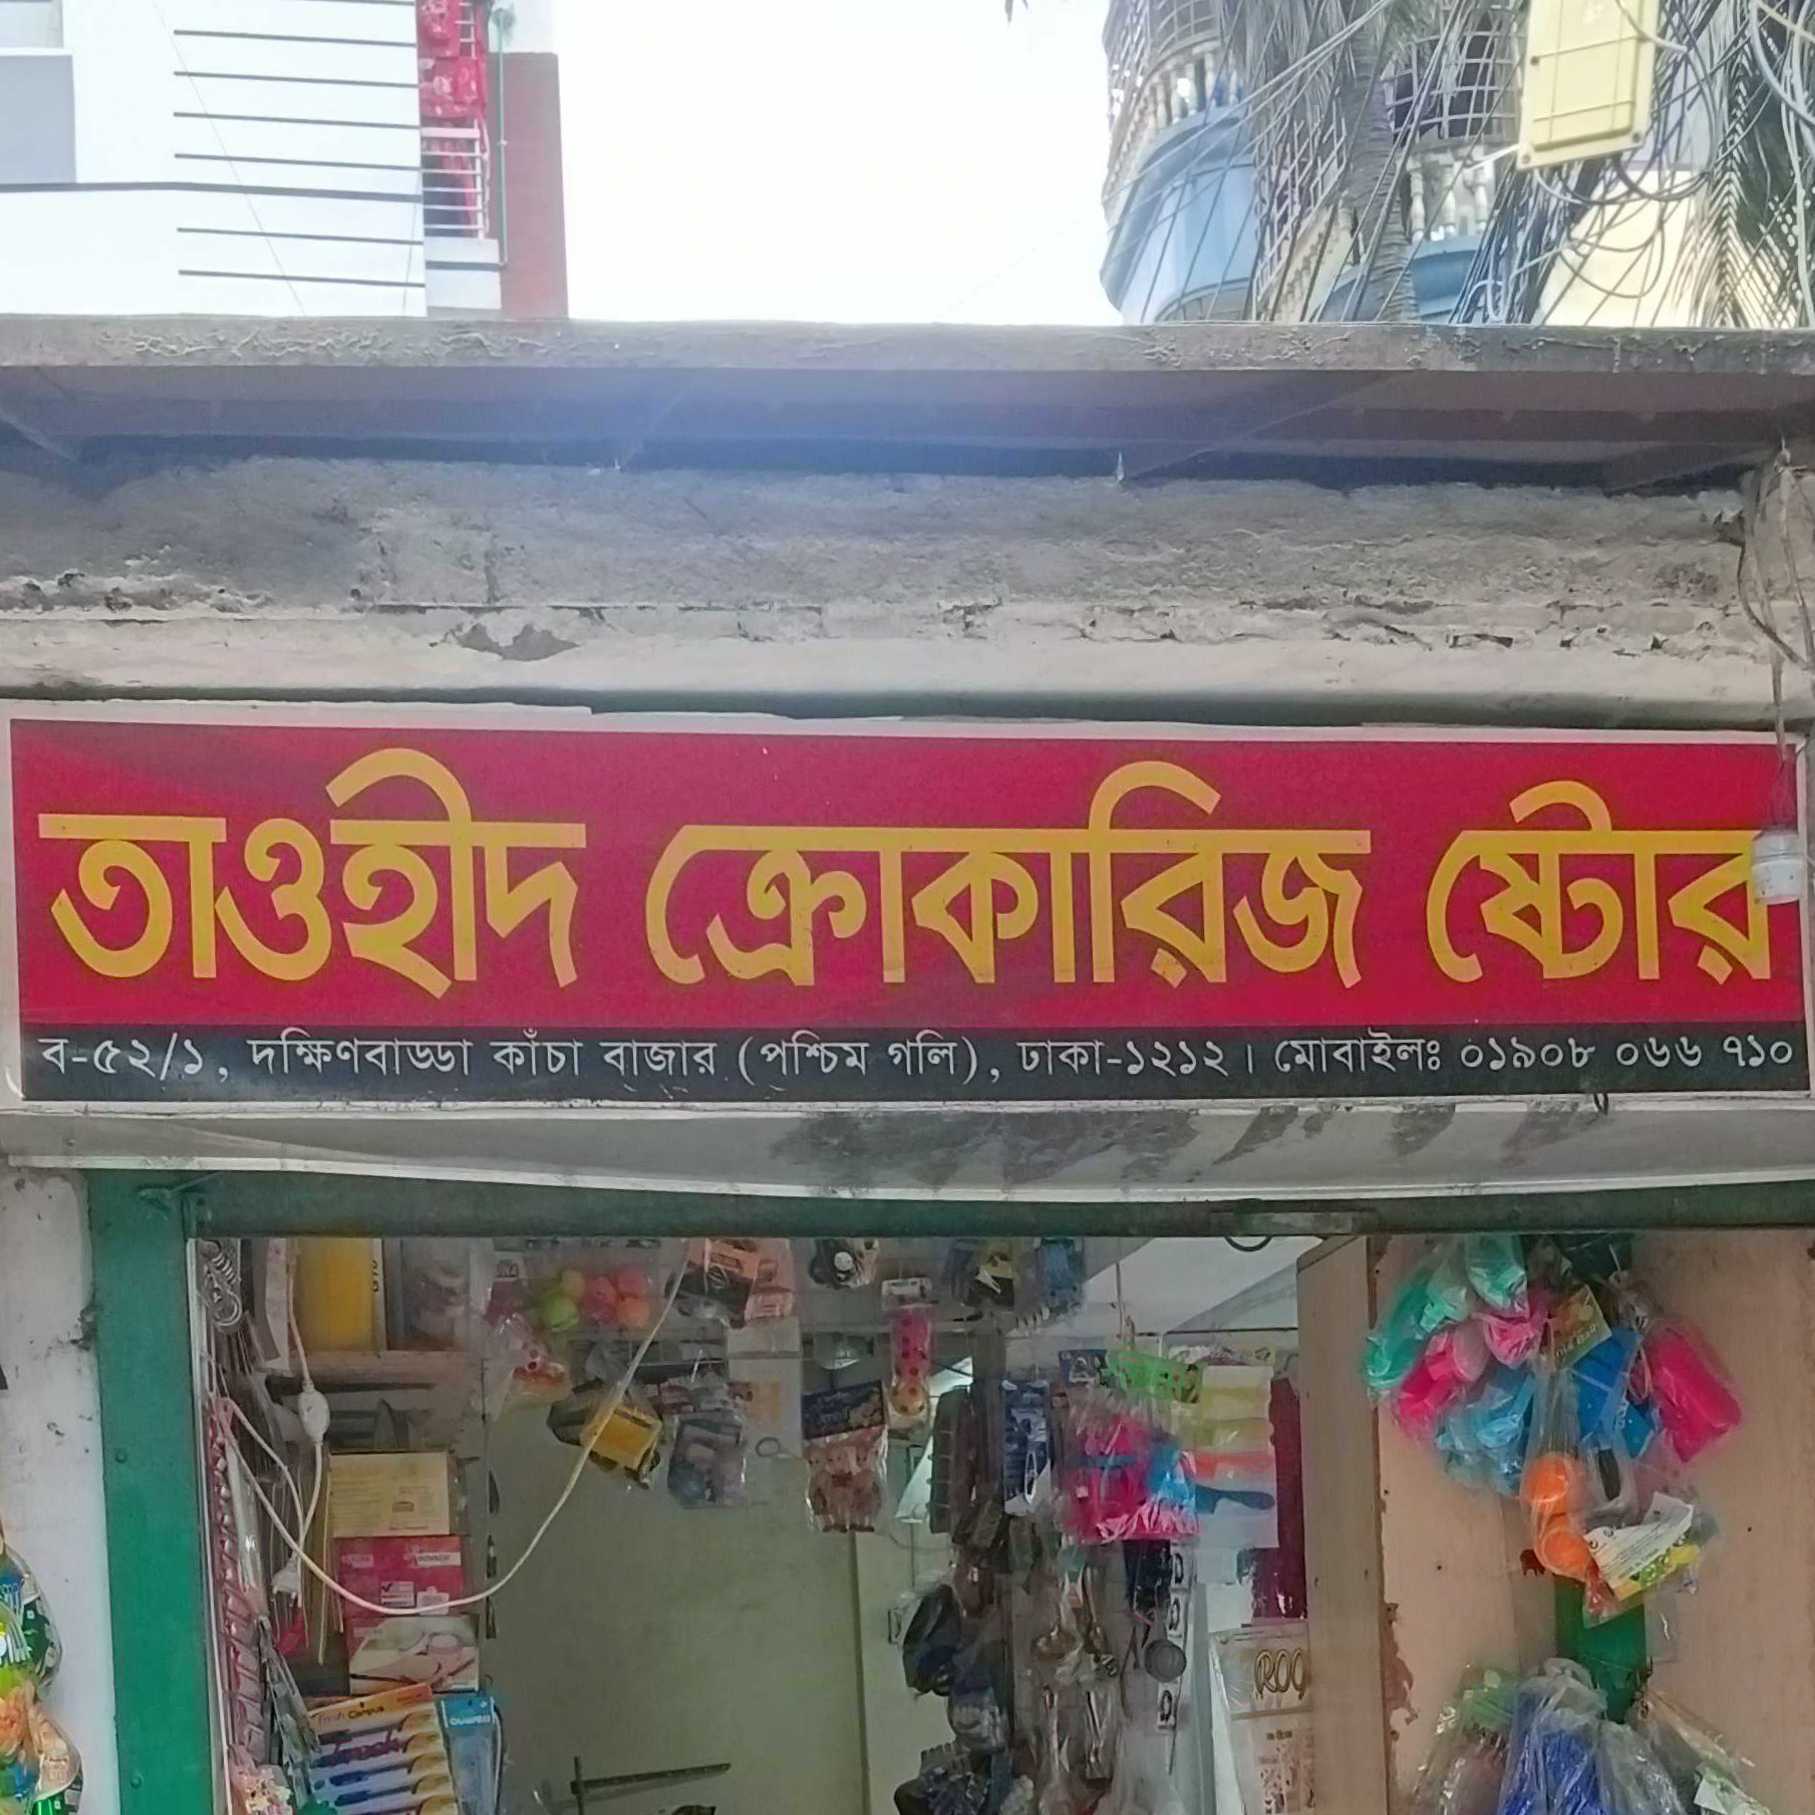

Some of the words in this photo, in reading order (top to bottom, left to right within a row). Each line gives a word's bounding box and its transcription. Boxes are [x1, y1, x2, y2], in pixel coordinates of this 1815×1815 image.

[37, 747, 588, 999] তাওহীদ
[645, 760, 1372, 989] ক্রোকারিজ
[37, 1032, 229, 1083] ব-৫২/১,
[246, 1027, 474, 1076] দক্ষিণবাড্ডা
[488, 1028, 583, 1076] কাঁচা
[599, 1040, 718, 1077] বাজার
[738, 1029, 870, 1085] (পশ্চিম
[887, 1029, 1000, 1085] গলি),
[1016, 1040, 1229, 1077] ঢাকা-১২১২
[1274, 1027, 1441, 1074] মোবাইলঃ
[1460, 1036, 1596, 1071] ০১৯০৮
[1616, 1035, 1702, 1068] ০৬৬
[1722, 1034, 1793, 1067] ৭১০
